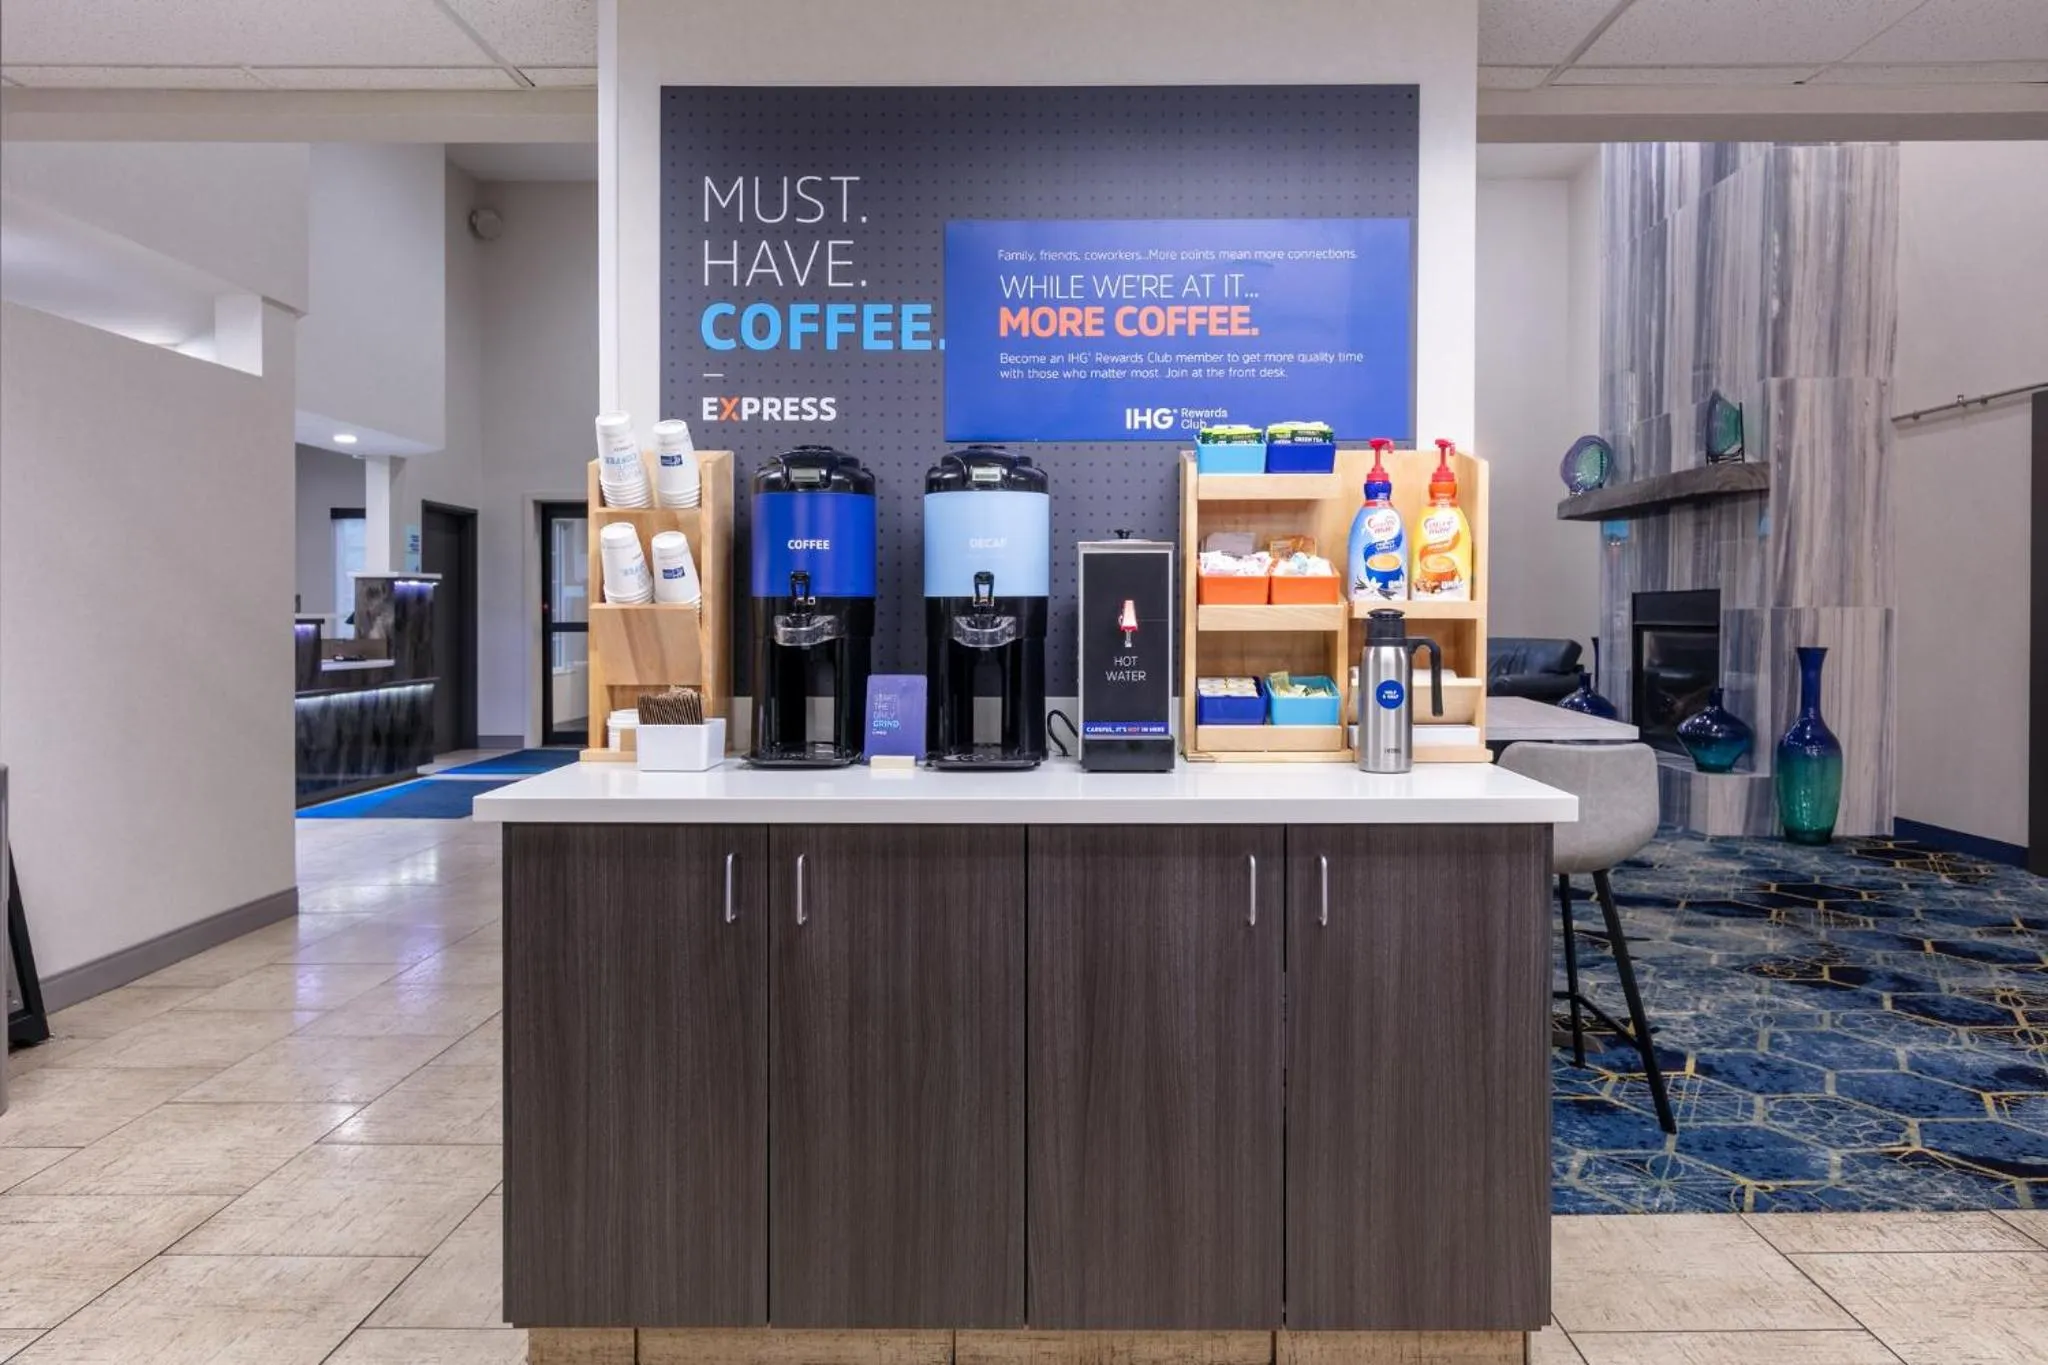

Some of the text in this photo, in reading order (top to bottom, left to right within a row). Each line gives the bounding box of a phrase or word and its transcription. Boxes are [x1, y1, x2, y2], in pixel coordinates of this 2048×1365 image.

[704, 176, 867, 223] MUST.
[998, 249, 1037, 262] Family,
[1180, 249, 1216, 261] points
[1218, 250, 1252, 260] mean
[1254, 250, 1285, 260] more
[704, 240, 867, 286] HAVE.
[999, 273, 1259, 299] WHILE WE'RE AT IT...
[999, 305, 1260, 337] MORE COFFEE.
[999, 352, 1047, 364] Become
[1049, 354, 1065, 364] an
[1095, 352, 1144, 364] Rewards
[1147, 352, 1173, 364] Club
[1176, 352, 1224, 363] member
[1227, 352, 1240, 363] to
[1242, 353, 1261, 365] get
[1264, 353, 1295, 363] more
[1298, 352, 1335, 364] quality
[1338, 352, 1364, 363] time
[999, 367, 1024, 379] with
[1027, 367, 1059, 379] those
[1063, 367, 1088, 379] who
[1090, 368, 1127, 379] matter
[1165, 367, 1189, 379] Join
[1191, 368, 1204, 378] at
[1206, 367, 1225, 378] the
[1228, 367, 1256, 378] front
[702, 397, 837, 421] EXPRESS
[1181, 407, 1228, 418] Rewards
[1181, 419, 1208, 430] Club
[787, 539, 830, 550] COFFEE
[968, 537, 1007, 548] DECAF
[1113, 656, 1138, 667] HOT
[1105, 671, 1147, 681] WATER
